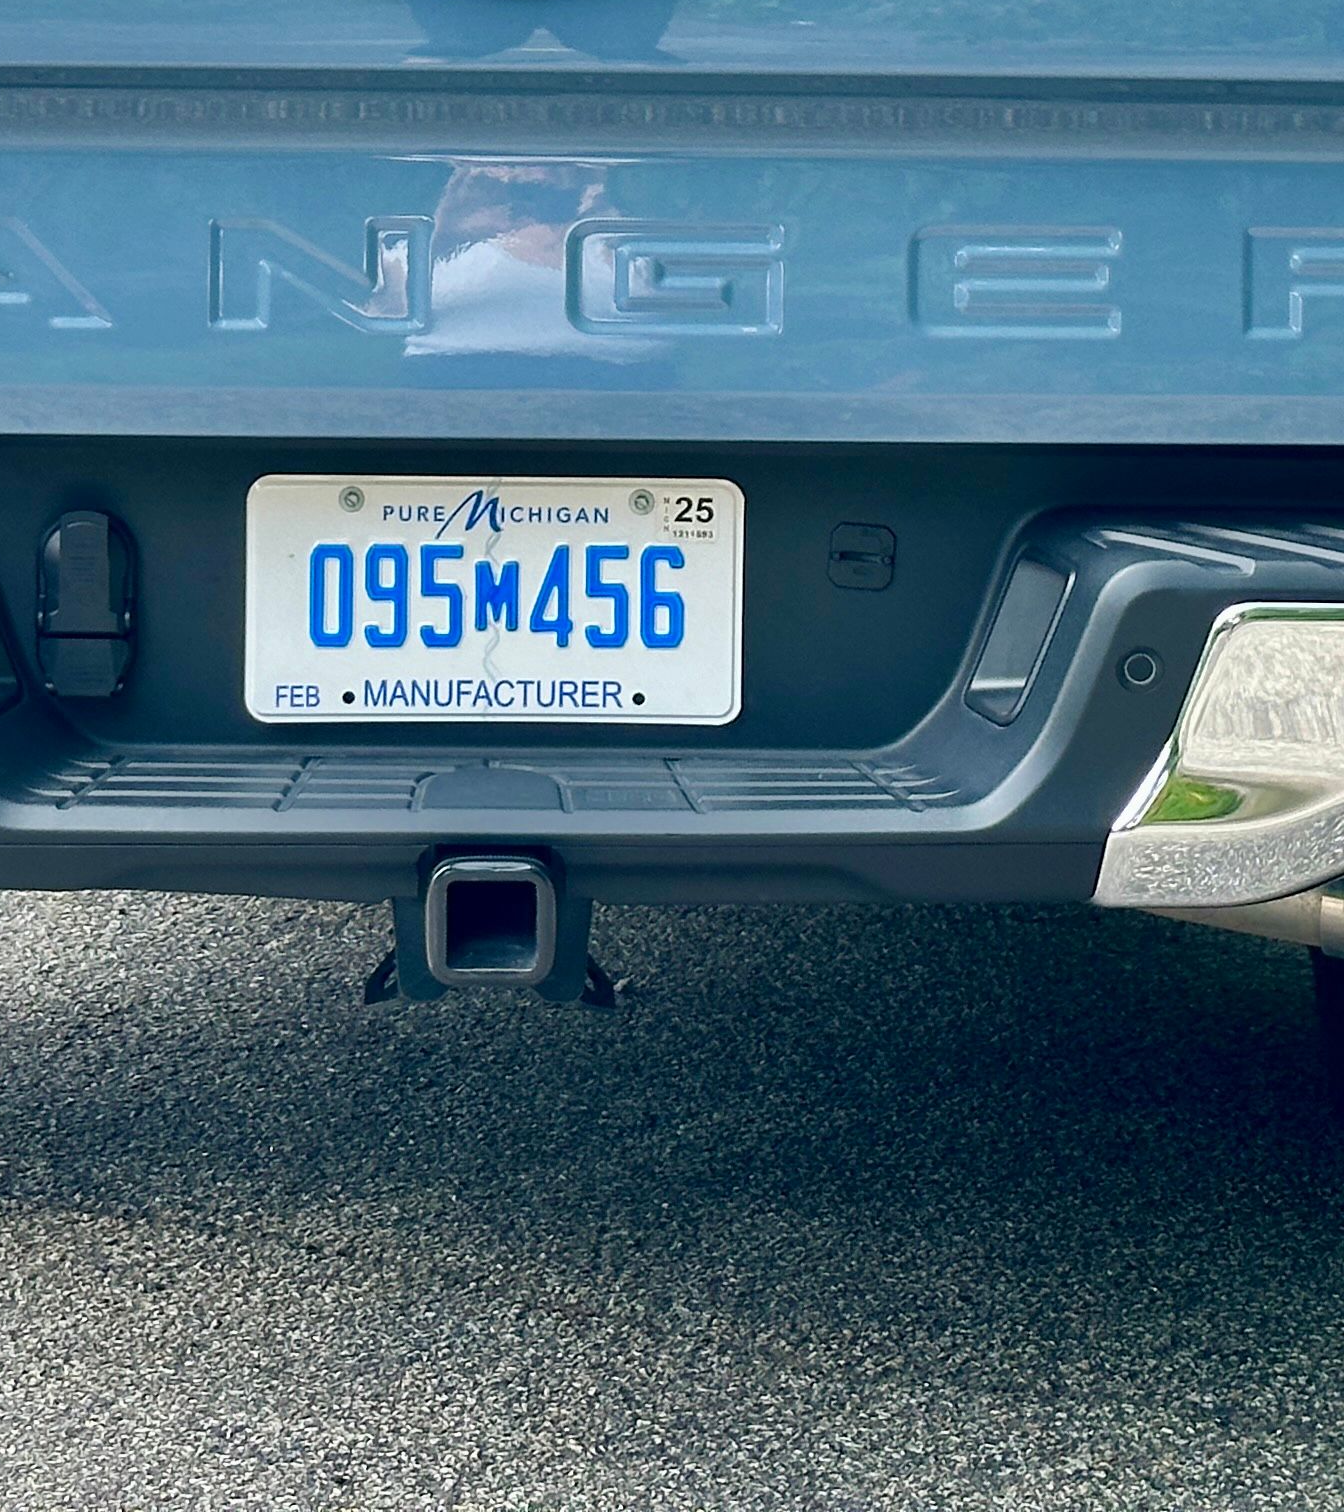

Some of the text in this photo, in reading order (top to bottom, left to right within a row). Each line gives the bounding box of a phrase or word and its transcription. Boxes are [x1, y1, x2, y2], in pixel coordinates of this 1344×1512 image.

[382, 489, 610, 539] PURE MICHIGAN
[674, 497, 714, 523] 25
[309, 543, 686, 649] 095M456
[275, 685, 321, 707] FEB
[363, 680, 623, 708] MANUFACTURER
